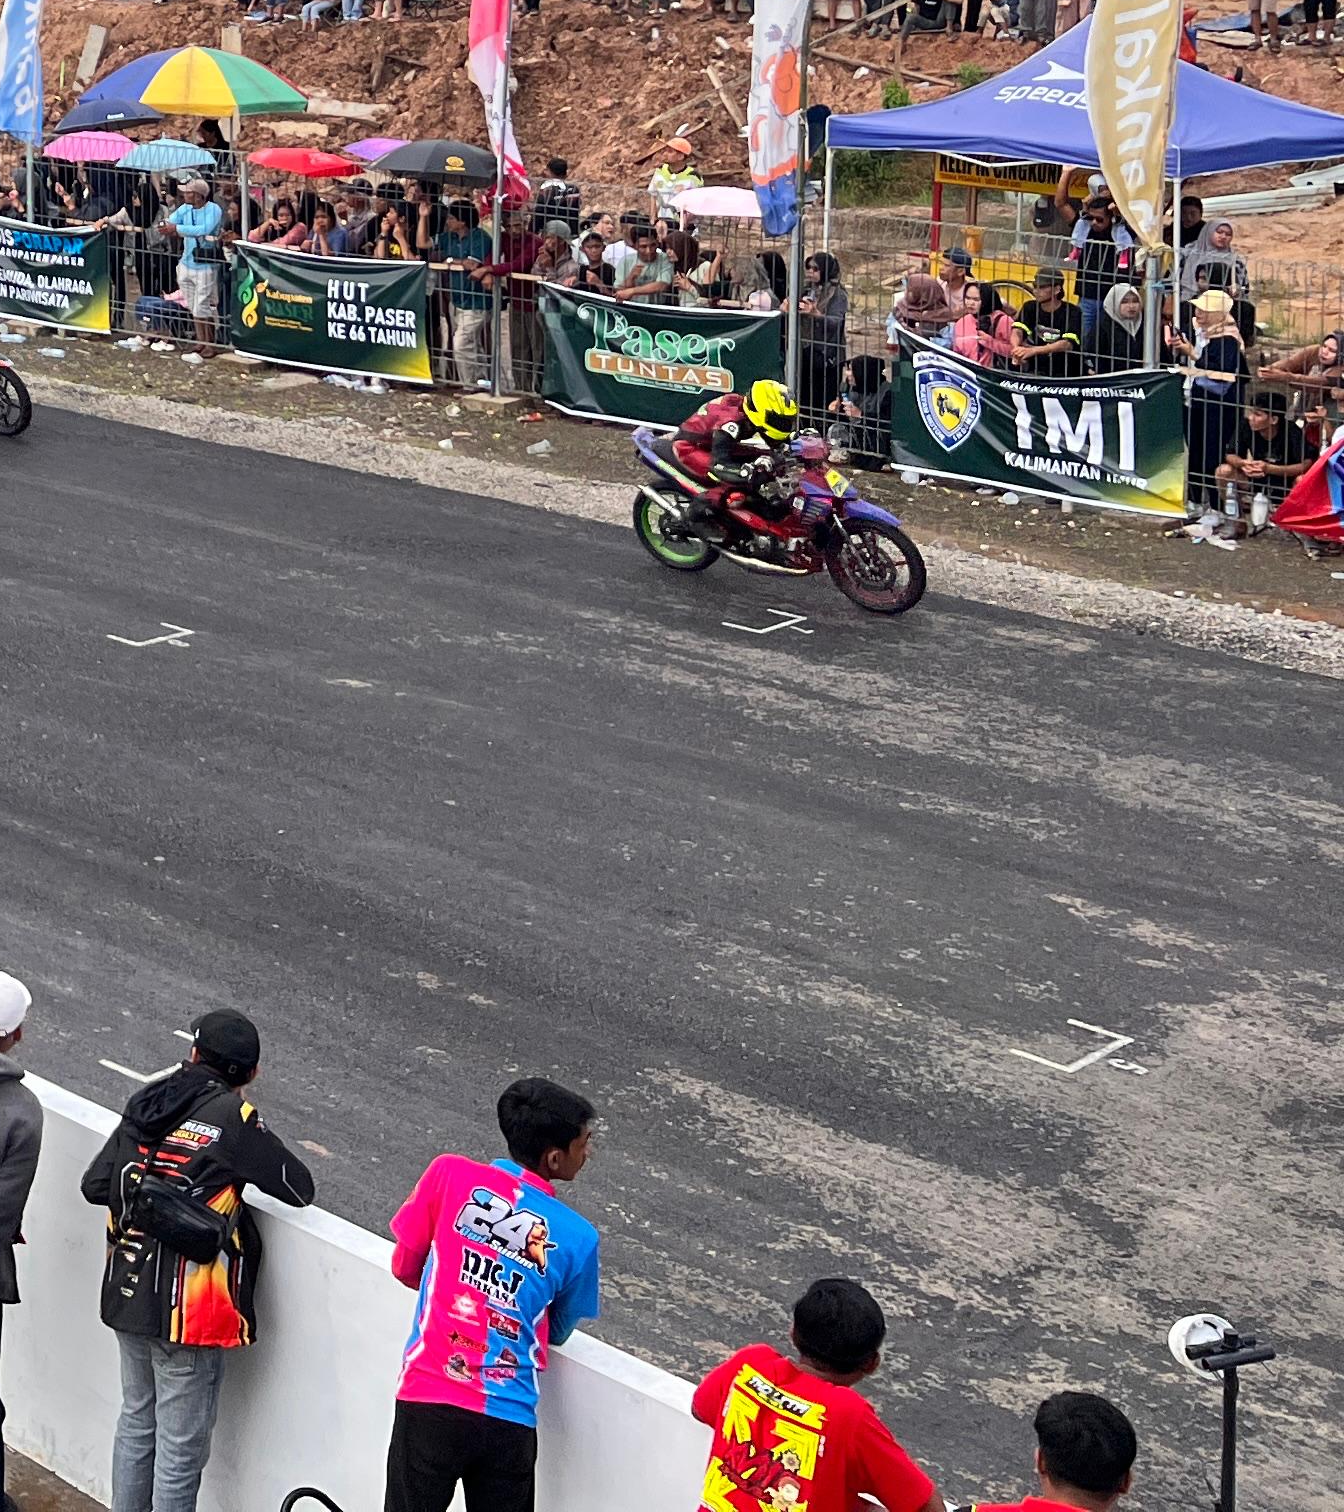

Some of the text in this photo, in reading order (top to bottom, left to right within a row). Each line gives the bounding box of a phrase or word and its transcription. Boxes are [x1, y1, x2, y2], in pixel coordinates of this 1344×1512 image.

[37, 274, 94, 296] OLAHRAGA
[326, 302, 416, 329] KAB. PASER
[327, 322, 347, 339] KE
[349, 325, 365, 342] 66
[368, 327, 417, 348] TAHUN
[577, 302, 736, 368] Paser
[595, 354, 722, 387] TUNTAS
[1080, 386, 1146, 400] INDONESIA
[1012, 394, 1135, 471] IMI
[1004, 451, 1101, 481] KALIMANTAN
[455, 1189, 544, 1253] 24
